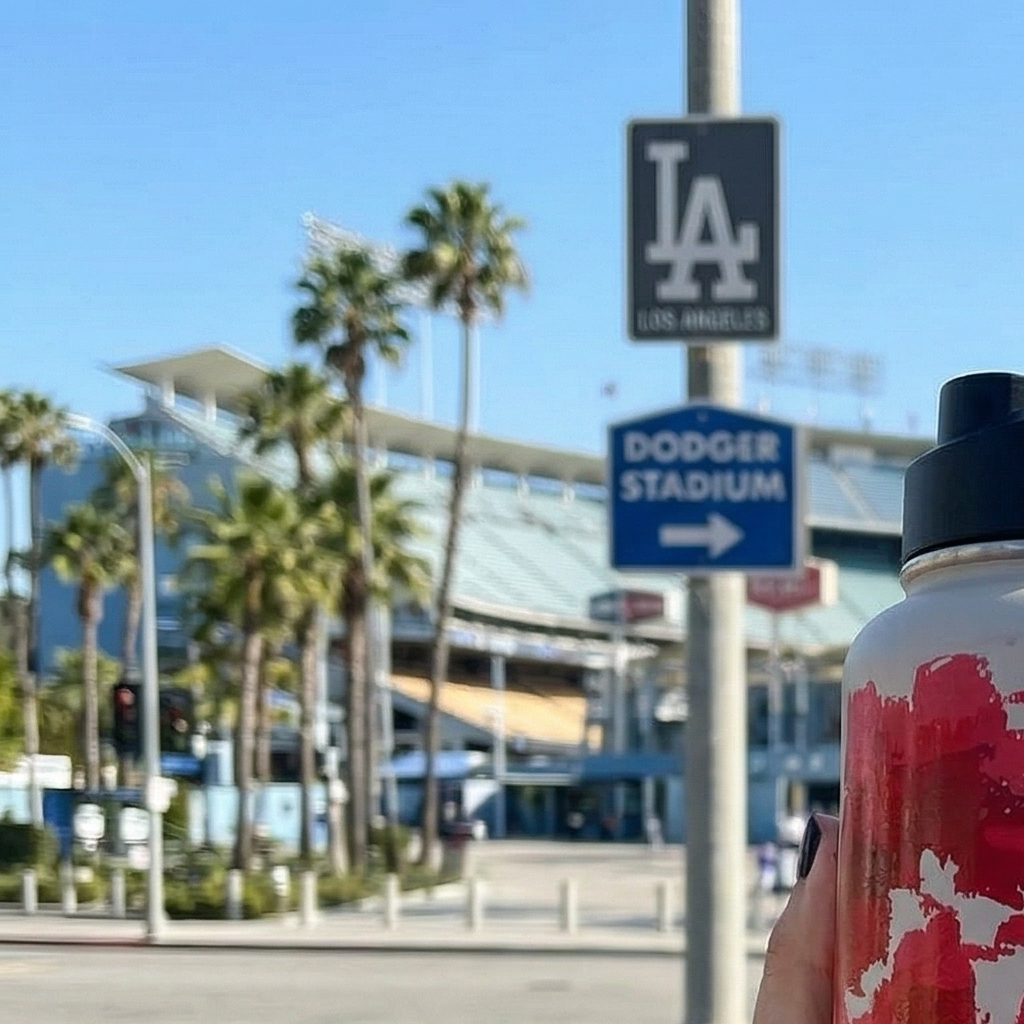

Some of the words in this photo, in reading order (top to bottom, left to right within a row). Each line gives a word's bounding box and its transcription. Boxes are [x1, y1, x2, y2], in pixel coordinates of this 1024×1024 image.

[646, 142, 759, 299] LA
[624, 431, 780, 463] DODGER
[620, 470, 787, 502] STADIUM
